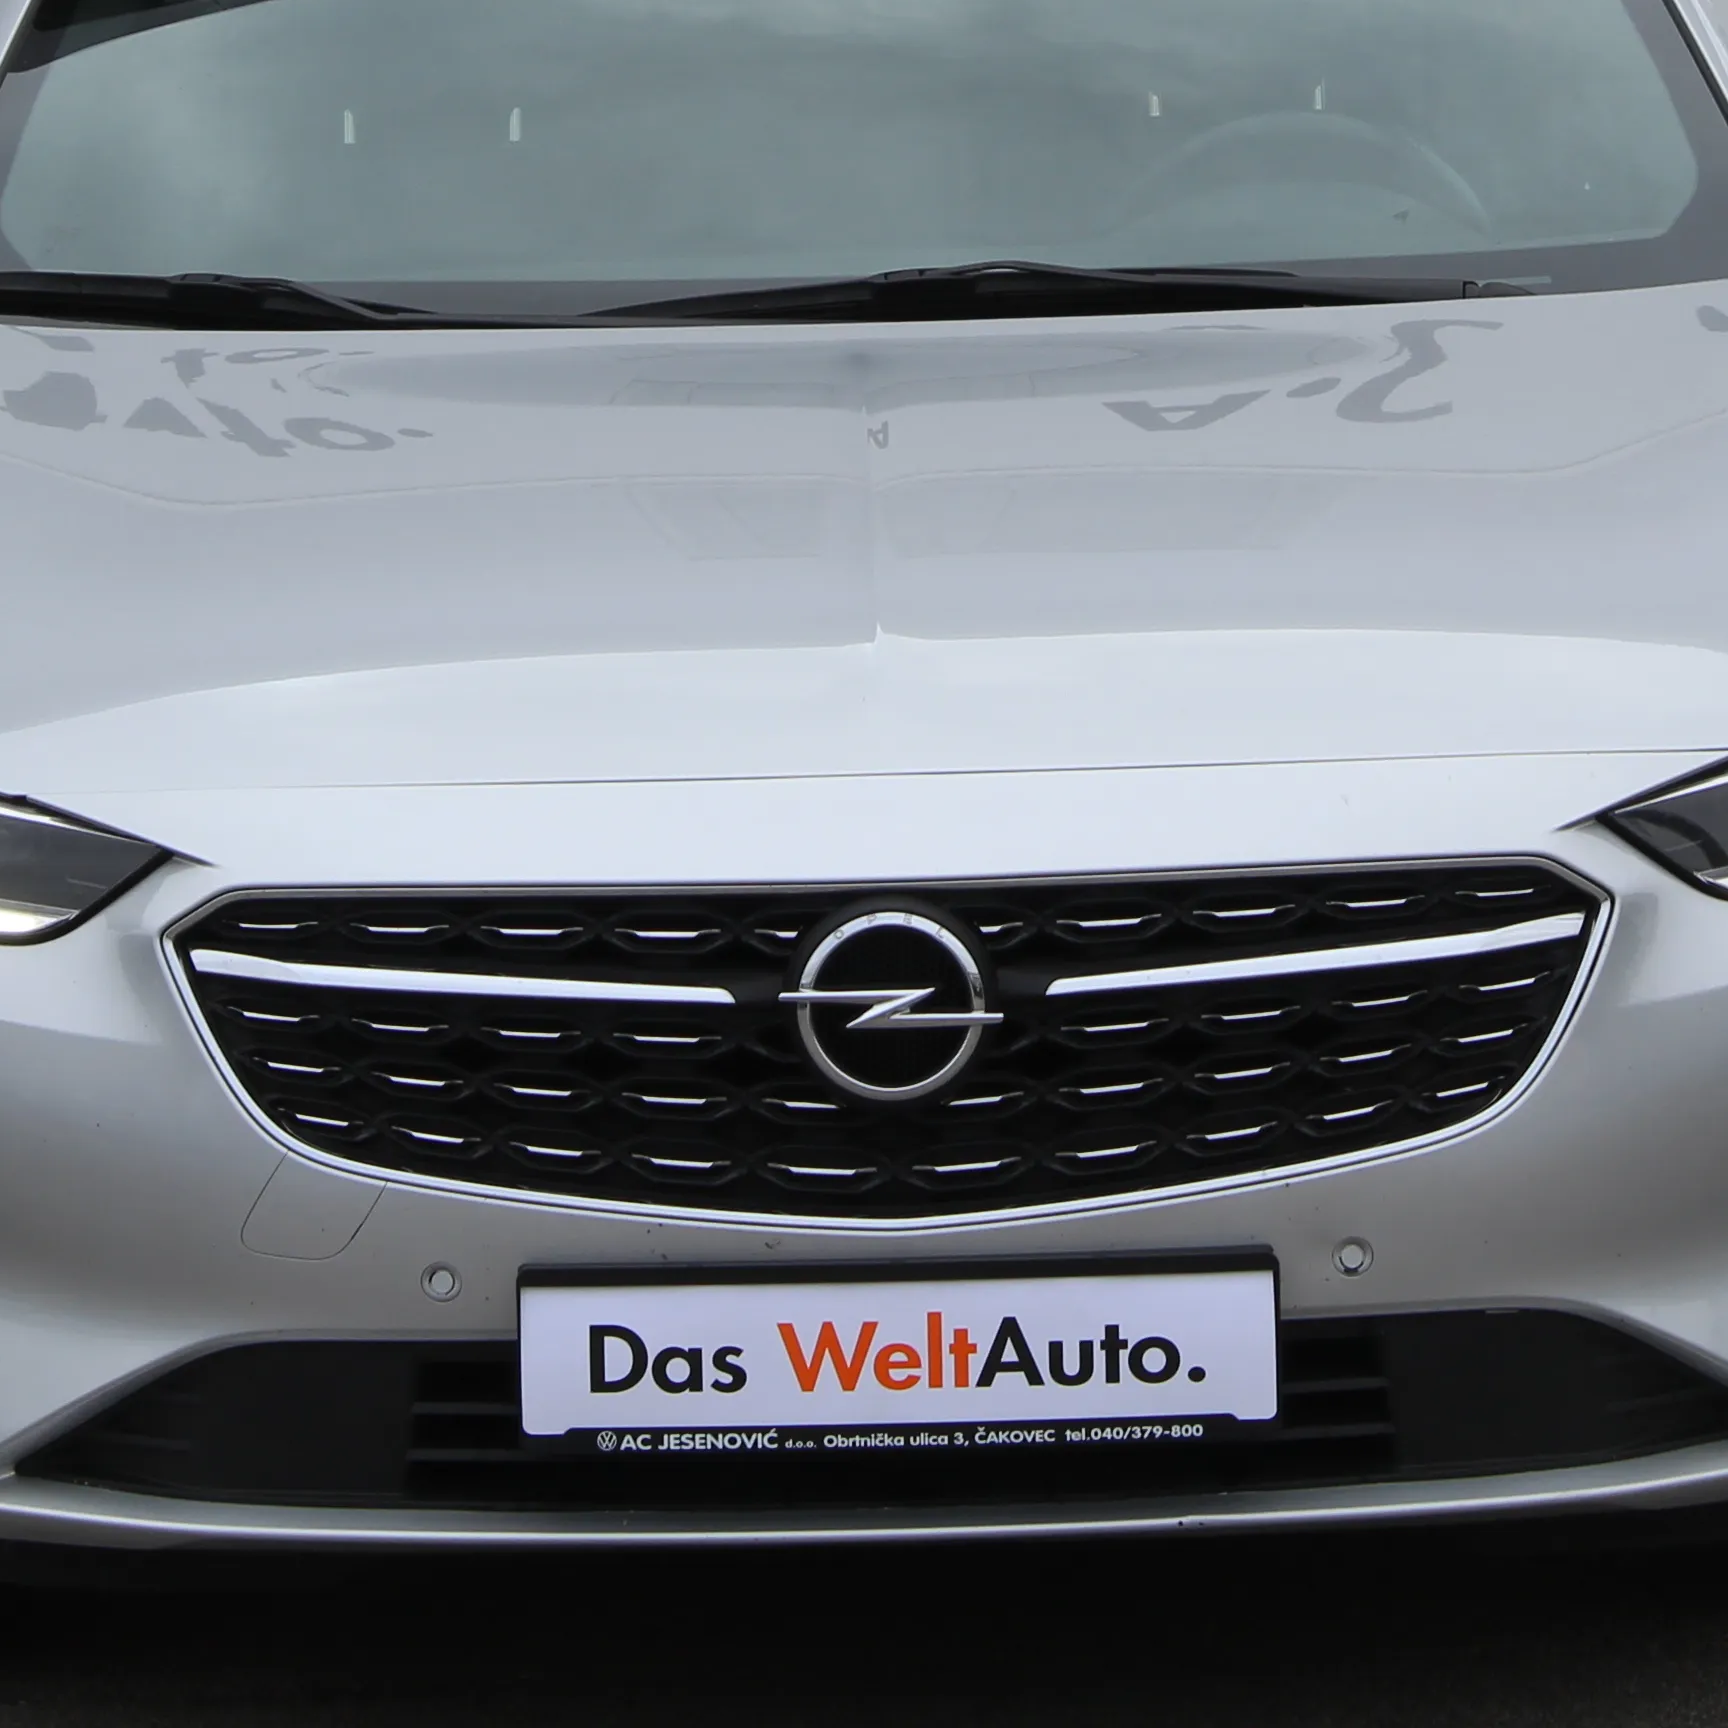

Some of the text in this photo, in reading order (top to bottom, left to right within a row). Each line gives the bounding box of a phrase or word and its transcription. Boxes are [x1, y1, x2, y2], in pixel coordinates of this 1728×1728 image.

[588, 1310, 1208, 1395] Das WeltAuto.
[620, 1433, 652, 1451] AC
[658, 1428, 779, 1450] JESENOVIĆ
[784, 1439, 817, 1449] d.o.o.
[823, 1432, 905, 1448] Obrtnička
[909, 1432, 949, 1447] ulica
[954, 1433, 970, 1447] 3,
[974, 1426, 1056, 1445] ČAKOVEC
